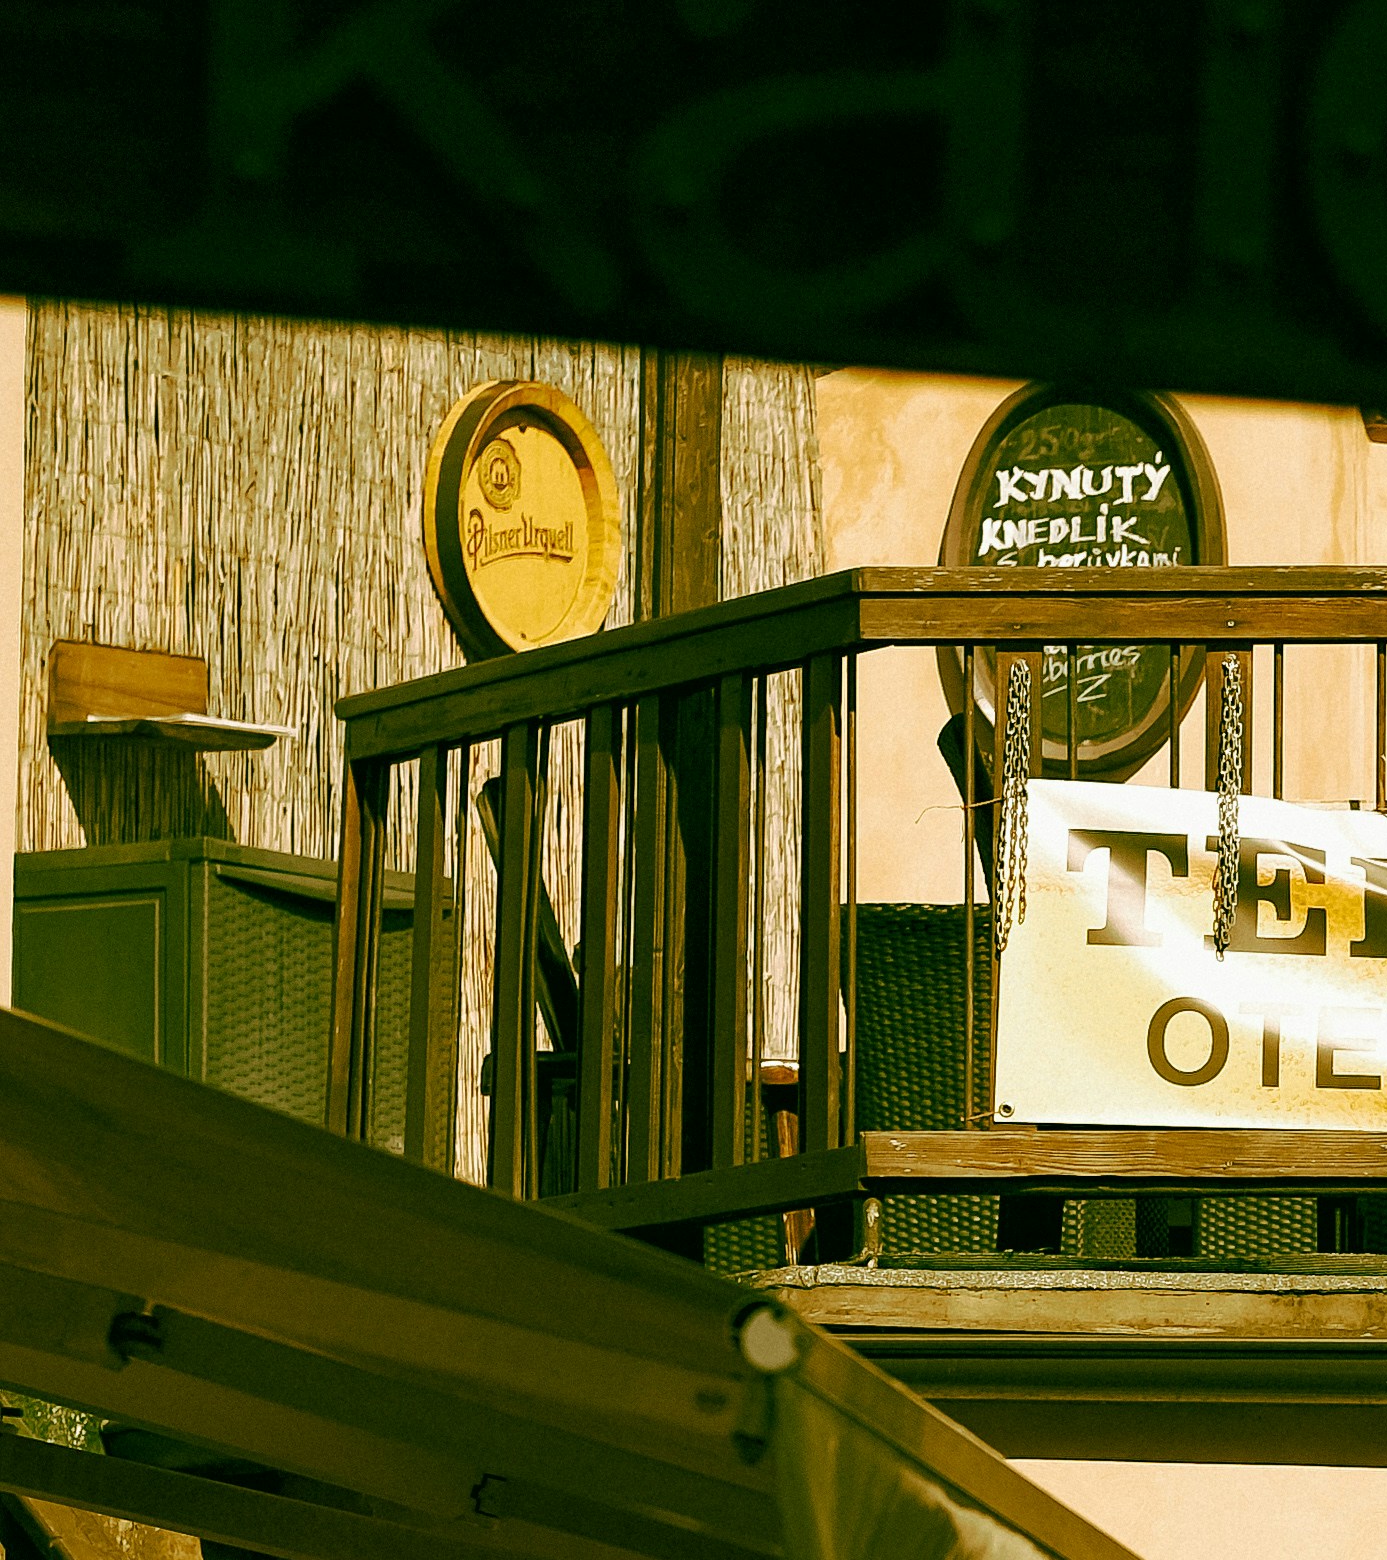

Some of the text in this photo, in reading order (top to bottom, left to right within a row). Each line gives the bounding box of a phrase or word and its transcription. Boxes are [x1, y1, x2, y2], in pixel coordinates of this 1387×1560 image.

[993, 450, 1171, 508] KYNUTÝ
[467, 509, 574, 571] Pilsner Urquell
[978, 503, 1151, 556] KNEDLÍK
